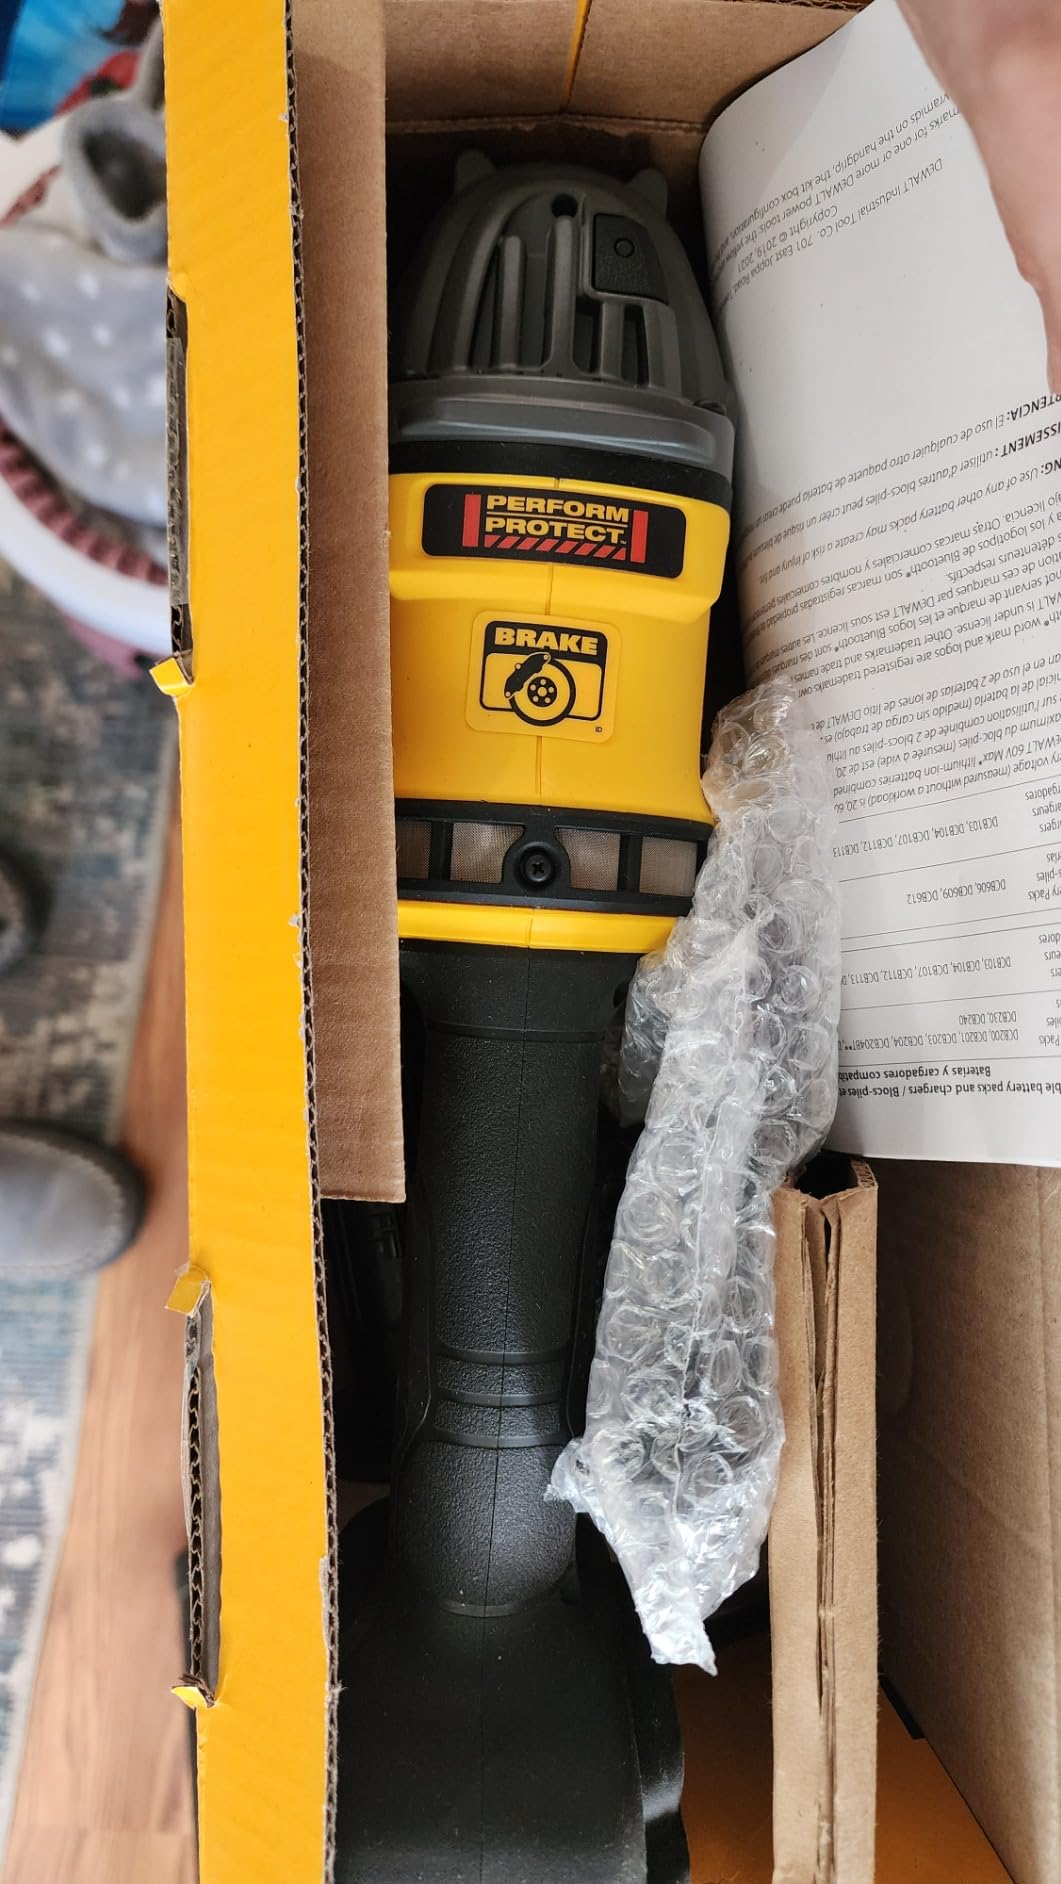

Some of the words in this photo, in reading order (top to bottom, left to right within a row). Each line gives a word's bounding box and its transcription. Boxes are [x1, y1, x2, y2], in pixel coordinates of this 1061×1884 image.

[896, 119, 909, 134] on
[914, 125, 928, 142] for
[878, 129, 895, 145] the
[893, 136, 912, 154] one
[832, 141, 877, 174] handgrip,
[855, 157, 880, 179] more
[812, 170, 832, 185] the
[780, 186, 800, 202] box
[782, 195, 815, 220] power
[858, 185, 903, 220] Industrial
[730, 197, 780, 240] configuration
[789, 205, 838, 236] Copyright
[834, 213, 857, 233] Tool
[754, 236, 778, 258] 2019,
[796, 235, 814, 251] 701
[772, 244, 793, 262] East
[750, 254, 775, 277] Joppa
[960, 428, 973, 441] de
[975, 419, 993, 434] uso
[912, 434, 958, 460] cualquier
[889, 453, 912, 468] otro
[957, 450, 993, 472] utiliser
[848, 459, 888, 483] paquete
[1019, 467, 1039, 482] Use
[833, 477, 849, 489] de
[985, 481, 1005, 496] any
[865, 480, 916, 506] blocs-piles
[956, 489, 983, 507] other
[487, 495, 629, 522] PERFORM
[839, 496, 864, 515] peut
[915, 500, 957, 520] battery
[1002, 500, 1046, 523] licencia.
[815, 507, 841, 523] créer
[889, 510, 917, 531] packs
[865, 523, 887, 539] may
[972, 518, 1001, 535] Otras
[1029, 518, 1045, 532] los
[834, 531, 866, 549] create
[934, 528, 971, 549] marcas
[977, 525, 1028, 552] logotipos
[811, 545, 826, 560] risk
[872, 542, 932, 568] comerciales
[962, 544, 976, 557] de
[998, 536, 1055, 564] détenteurs
[820, 565, 862, 586] nombres
[884, 568, 903, 581] son
[945, 557, 996, 583] respectifs.
[1002, 567, 1020, 581] ces
[1021, 562, 1036, 575] de
[846, 575, 882, 594] marcas
[954, 574, 1000, 597] marques
[1003, 577, 1043, 599] servant
[774, 580, 820, 606] comerciales
[799, 586, 845, 611] registradas
[936, 587, 954, 603] par
[988, 592, 1002, 605] de
[945, 596, 986, 616] marque
[993, 604, 1024, 623] under
[850, 614, 873, 628] sous
[875, 609, 890, 622] est
[918, 614, 933, 625] les
[934, 610, 945, 621] et
[816, 622, 849, 640] licence.
[888, 618, 917, 634] logos
[954, 616, 992, 634] license.
[1013, 617, 1041, 636] word
[495, 627, 598, 655] BRAKE
[924, 628, 953, 644] Other
[964, 636, 984, 651] and
[985, 627, 1011, 644] mark
[814, 644, 832, 658] sont
[864, 637, 921, 660] trademarks
[934, 642, 962, 658] logos
[844, 653, 862, 669] and
[916, 651, 932, 663] are
[1033, 658, 1046, 670] en
[819, 659, 843, 675] trade
[863, 656, 914, 680] registered
[1002, 666, 1020, 679] uso
[1022, 663, 1031, 676] el
[813, 670, 862, 693] trademarks
[988, 672, 1001, 684] de
[940, 678, 981, 699] baterías
[1010, 685, 1020, 696] la
[1021, 680, 1035, 693] de
[898, 693, 924, 708] iones
[926, 690, 939, 702] de
[974, 688, 1008, 707] batería
[1041, 695, 1057, 707] sur
[863, 703, 881, 719] litio
[883, 700, 898, 713] de
[932, 697, 972, 718] (medido
[885, 713, 914, 728] carga
[916, 709, 931, 721] sin
[832, 724, 869, 743] trabajo)
[870, 721, 883, 733] de
[924, 728, 937, 740] de
[938, 715, 986, 737] combinée
[1005, 725, 1018, 737] du
[862, 733, 914, 754] blocs-piles
[957, 728, 1003, 748] bloc-piles
[912, 739, 956, 760] (mesurée
[1006, 744, 1024, 758] 60V
[848, 763, 860, 775] de
[861, 759, 875, 771] est
[877, 754, 901, 769] vide)
[923, 756, 976, 776] lithium-ion
[1013, 756, 1049, 773] voltage
[835, 766, 847, 778] 20,
[878, 769, 922, 786] batteries
[963, 764, 1011, 788] (measured
[833, 778, 877, 798] combined
[925, 777, 962, 794] without
[867, 788, 916, 807] workload)
[931, 823, 965, 839] DCB104,
[966, 816, 999, 832] DCB103,
[860, 836, 894, 852] DCB112,
[894, 830, 930, 846] DCB107,
[832, 843, 859, 858] DCB113
[940, 884, 973, 899] DCB609,
[974, 878, 1006, 894] DCB606,
[906, 890, 939, 905] DCB612
[1028, 889, 1050, 902] Packs
[915, 962, 949, 977] DCB107,
[950, 960, 980, 973] DCB104,
[982, 956, 1011, 970] DCB103,
[848, 971, 879, 985] DCB113,
[880, 968, 913, 981] DCB112,
[958, 1013, 986, 1025] DCB240
[987, 1010, 1017, 1023] DCB230,
[891, 1035, 924, 1047] DCB204,
[925, 1033, 957, 1045] DCB203,
[958, 1030, 987, 1043] DCB201,
[989, 1027, 1018, 1041] DCB200,
[1039, 1035, 1060, 1047] Packs
[883, 1066, 939, 1080] cargadores
[942, 1065, 949, 1076] y
[952, 1066, 991, 1077] Baterías
[847, 1086, 899, 1099] Blocs-piles
[908, 1083, 952, 1095] chargers
[956, 1084, 975, 1095] and
[977, 1081, 1004, 1095] packs
[1007, 1080, 1043, 1094] battery
